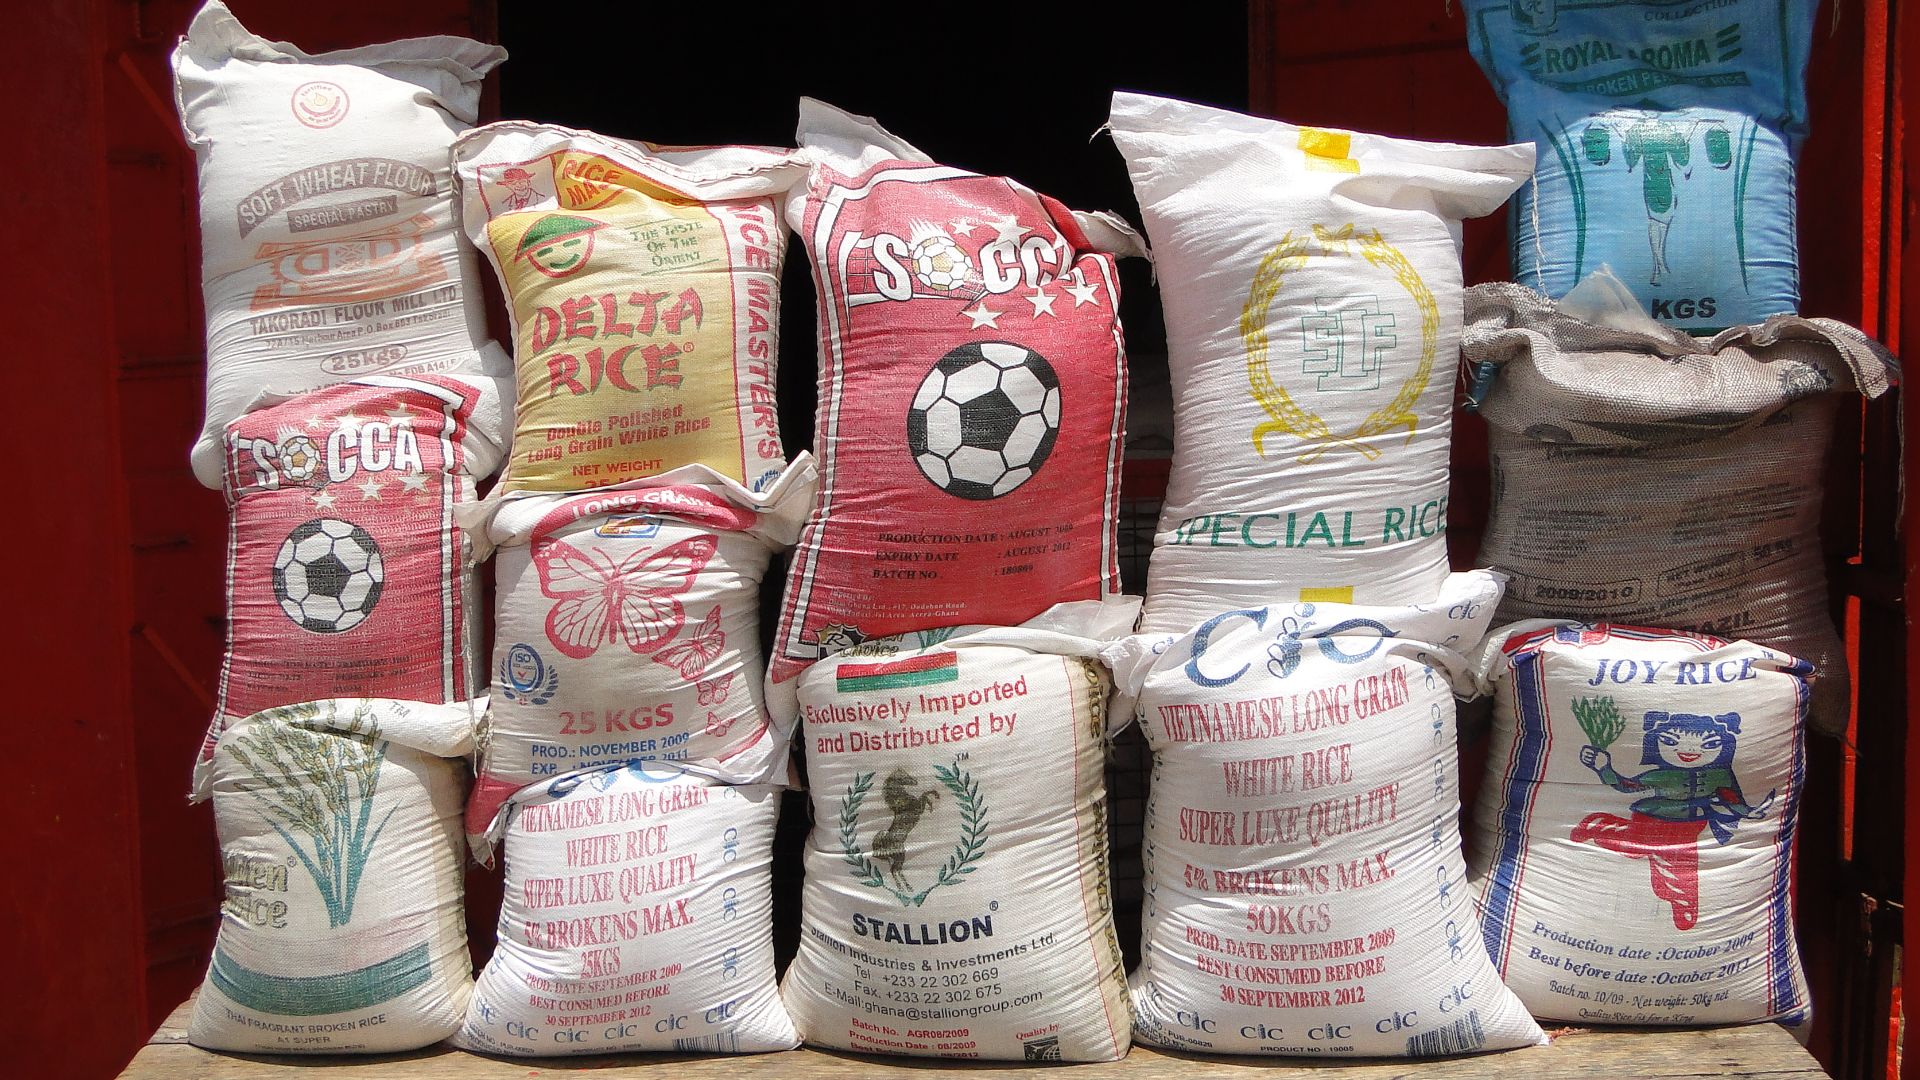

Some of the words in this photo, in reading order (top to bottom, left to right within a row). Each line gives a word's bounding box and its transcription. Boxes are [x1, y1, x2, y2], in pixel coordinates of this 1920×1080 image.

[1545, 40, 1622, 73] ROYAL
[562, 159, 625, 184] RICE
[240, 172, 286, 226] SOFT
[293, 162, 370, 208] WHEAT
[373, 162, 434, 195] FLOUR
[294, 209, 346, 229] SPECIAL
[349, 200, 397, 219] PASTRY
[630, 230, 660, 242] THE
[663, 221, 703, 237] TASTE
[646, 240, 666, 253] OF
[671, 237, 698, 248] THE
[651, 251, 701, 267] ORIENT
[250, 309, 327, 337] TAKORADI
[334, 303, 386, 324] FLOUR
[391, 295, 430, 314] MILL
[432, 284, 462, 306] LTD
[532, 287, 703, 354] DELTA
[1652, 298, 1717, 319] KGS
[331, 346, 401, 372] 25kgs
[547, 342, 683, 396] RICE
[747, 278, 781, 460] MASTER'S
[547, 420, 602, 442] Double
[608, 405, 683, 430] Polished
[527, 445, 563, 463] Long
[568, 434, 613, 455] Grain
[618, 424, 668, 446] White
[674, 416, 711, 435] Rice
[572, 464, 601, 476] NET
[606, 459, 663, 473] WEIGHT
[571, 494, 638, 519] LONG
[878, 533, 964, 544] PRODUCTION
[965, 532, 997, 544] DATE
[1007, 527, 1051, 540] AUGUST
[1167, 511, 1366, 549] SPECIAL
[1382, 496, 1448, 544] RICE
[874, 551, 921, 561] EXPIRY
[925, 552, 959, 562] DATE
[1005, 544, 1048, 557] AUGUST
[1052, 542, 1071, 552] 2012
[872, 569, 914, 579] BATCH
[515, 653, 531, 663] ISO
[1588, 658, 1668, 686] JOY
[1674, 657, 1757, 685] RICE
[807, 698, 911, 724] Exclusively
[919, 675, 1028, 715] Imported
[1158, 696, 1287, 743] VIETNAMESE
[1291, 684, 1350, 734] LONG
[1353, 664, 1411, 721] GRAIN
[559, 711, 597, 735] 25
[605, 703, 675, 733] KGS
[817, 731, 844, 753] and
[849, 716, 980, 752] Distributed
[989, 711, 1017, 736] by
[580, 739, 656, 757] NOVEMBER
[661, 732, 690, 748] 2009
[531, 763, 558, 775] EXP.
[662, 749, 688, 761] 2011
[1223, 754, 1296, 798] WHITE
[1301, 743, 1353, 791] RICE
[521, 797, 604, 833] VIETNAMESE
[608, 789, 654, 823] LONG
[658, 784, 709, 814] GRAIN
[1180, 807, 1237, 846] SUPER
[1240, 806, 1301, 846] LUXE
[1306, 782, 1400, 847] QUALITY
[566, 834, 621, 869] WHITE
[625, 824, 668, 861] RICE
[524, 878, 564, 909] SUPER
[567, 871, 614, 906] LUXE
[618, 853, 697, 905] QUALITY
[1184, 863, 1209, 892] 5%
[1213, 863, 1330, 897] BROKENS
[1336, 850, 1397, 893] MAX.
[546, 910, 639, 949] BROKENS
[642, 898, 694, 936] MAX.
[852, 912, 994, 946] STALLION
[1247, 904, 1332, 935] 50KGS
[811, 926, 847, 955] Stallion
[849, 946, 916, 972] Industries
[922, 958, 932, 972] &
[936, 943, 1027, 971] Investments
[1031, 932, 1058, 951] Ltd.
[1185, 925, 1224, 953] PROD.
[1226, 938, 1268, 961] DATE
[1270, 937, 1366, 962] SEPTEMBER
[1368, 926, 1396, 952] 2009
[1531, 920, 1614, 955] Production
[1618, 946, 1652, 960] date
[1655, 946, 1719, 961] :October
[1724, 932, 1755, 954] 2009
[581, 946, 622, 979] 25KGS
[854, 963, 871, 981] Tel
[882, 973, 916, 988] +233
[920, 975, 937, 989] 22
[943, 973, 968, 987] 302
[972, 967, 999, 982] 669
[1196, 953, 1232, 979] BEST
[1234, 964, 1321, 985] CONSUMED
[1325, 955, 1386, 983] BEFORE
[1528, 946, 1560, 968] Best
[1563, 959, 1611, 982] before
[1614, 970, 1647, 984] date
[1650, 969, 1713, 985] :October
[526, 972, 553, 993] PROD.
[554, 980, 586, 995] DATE
[588, 968, 658, 993] SEPTEMBER
[659, 963, 682, 980] 2009
[854, 980, 882, 999] Fax.
[886, 989, 919, 1004] +233
[924, 991, 941, 1005] 22
[945, 989, 971, 1003] 302
[975, 983, 1002, 999] 675
[1549, 979, 1575, 997] Batch
[1594, 988, 1624, 1006] 10/09
[1632, 995, 1653, 1007] Net
[1689, 992, 1713, 1008] 50kg
[1713, 989, 1729, 1002] net
[529, 994, 557, 1010] BEST
[558, 993, 622, 1012] CONSUMED
[625, 982, 671, 1003] BEFORE
[824, 981, 1043, 1021] E-Mail:ghana@stalliongroup.com
[1219, 984, 1235, 1004] 30
[1237, 987, 1332, 1008] SEPTEMBER
[1335, 985, 1366, 1006] 2012
[225, 1007, 246, 1025] THAI
[248, 1018, 304, 1033] FRAGRANT
[308, 1021, 356, 1033] BROKEN
[359, 1013, 387, 1028] RICE
[546, 1013, 557, 1025] 30
[557, 1009, 626, 1027] SEPTEMBER
[629, 1004, 651, 1018] 2012
[851, 1017, 890, 1034] Batch
[893, 1024, 910, 1036] No.
[906, 1028, 970, 1039] AGR08/2009
[1579, 1008, 1612, 1022] Quality
[1613, 1010, 1633, 1022] Rice
[293, 1036, 331, 1044] SUPER
[848, 1030, 902, 1047] Production
[904, 1041, 929, 1050] Date
[851, 1041, 873, 1052] Best
[1015, 1025, 1047, 1041] Quality
[1260, 1045, 1305, 1053] PRODUCT
